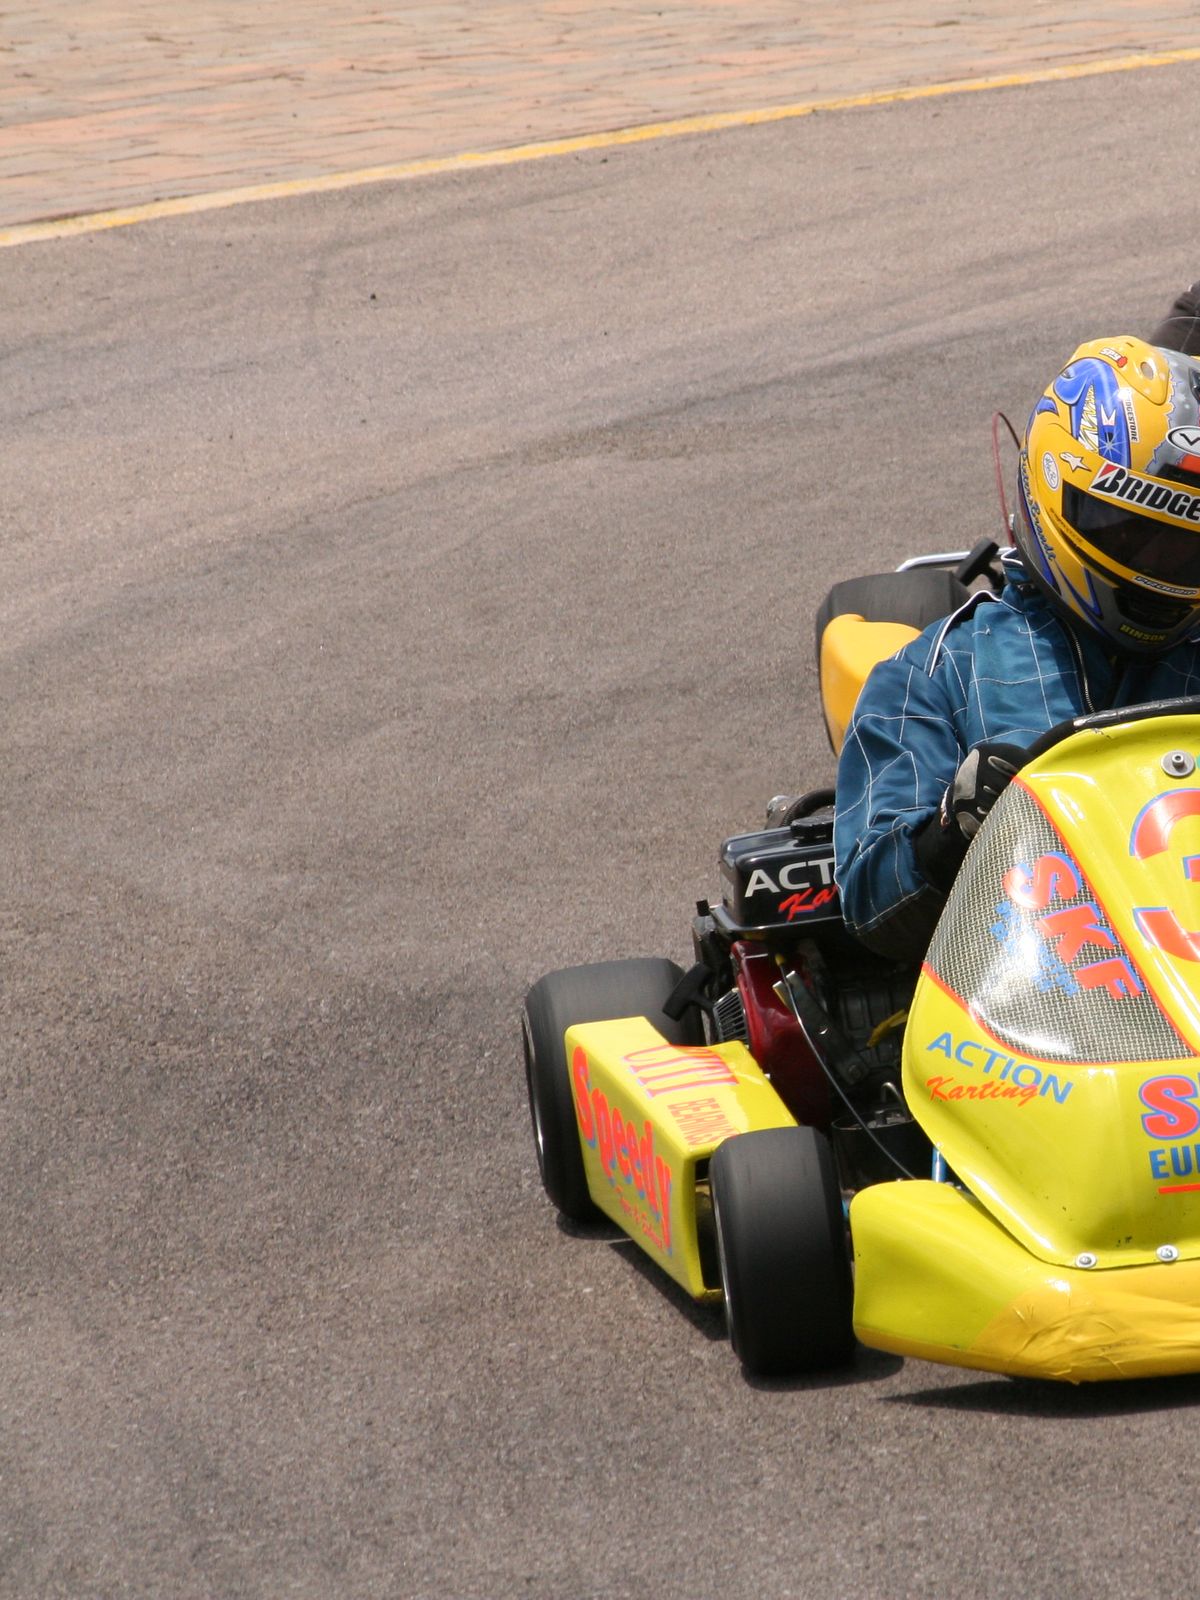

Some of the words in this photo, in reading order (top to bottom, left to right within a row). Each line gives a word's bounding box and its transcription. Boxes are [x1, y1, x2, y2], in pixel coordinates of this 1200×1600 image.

[744, 857, 836, 898] ACT
[1002, 850, 1146, 1000] SKF
[926, 1032, 1073, 1104] ACTION
[926, 1076, 1040, 1107] Karting
